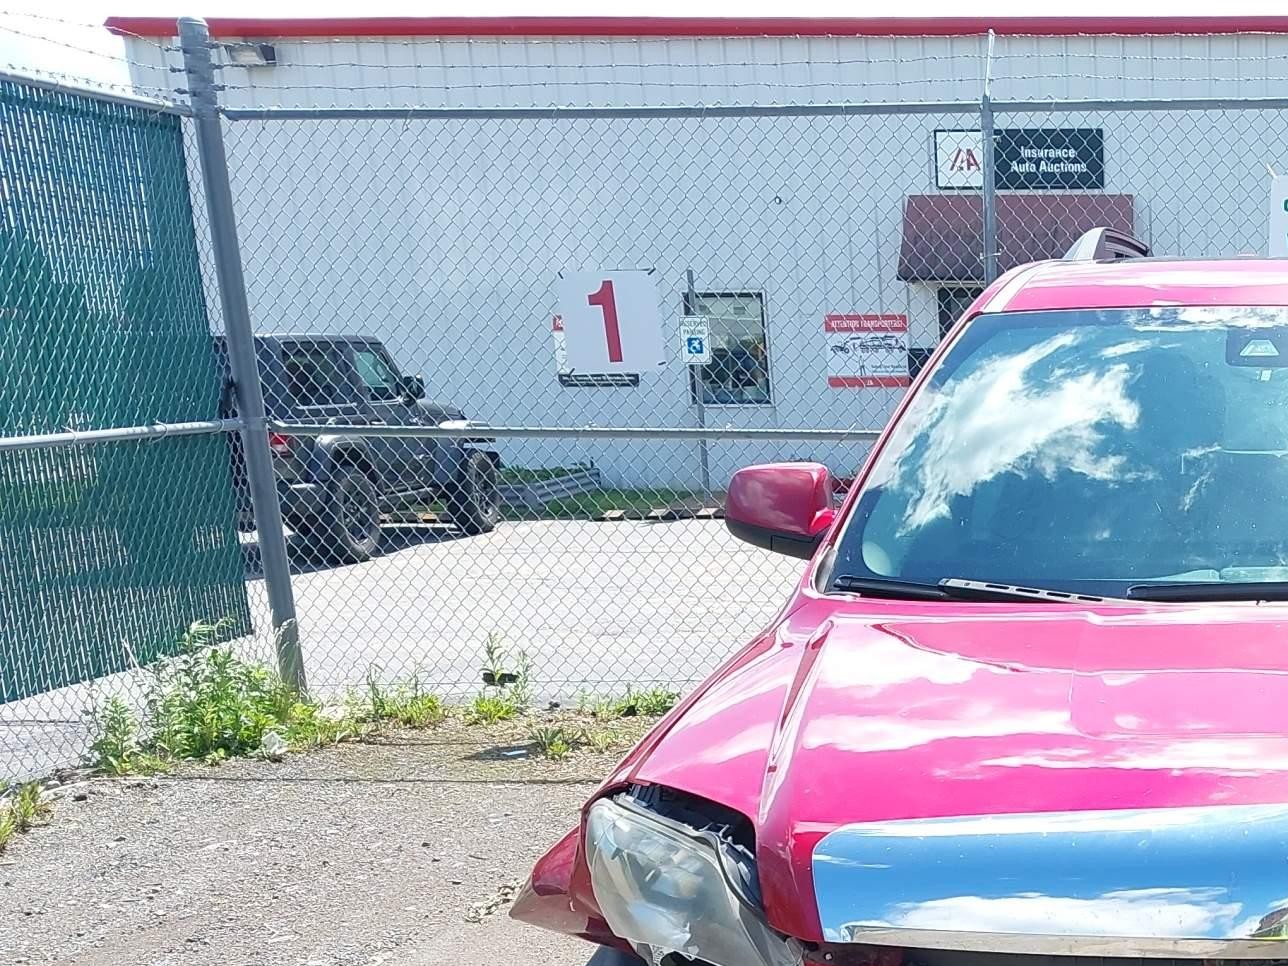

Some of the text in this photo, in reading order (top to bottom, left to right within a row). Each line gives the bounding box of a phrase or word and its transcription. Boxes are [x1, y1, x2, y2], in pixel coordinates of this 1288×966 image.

[1020, 146, 1076, 158] Insurance
[1011, 160, 1087, 173] Auto Auctions
[586, 279, 624, 364] 1
